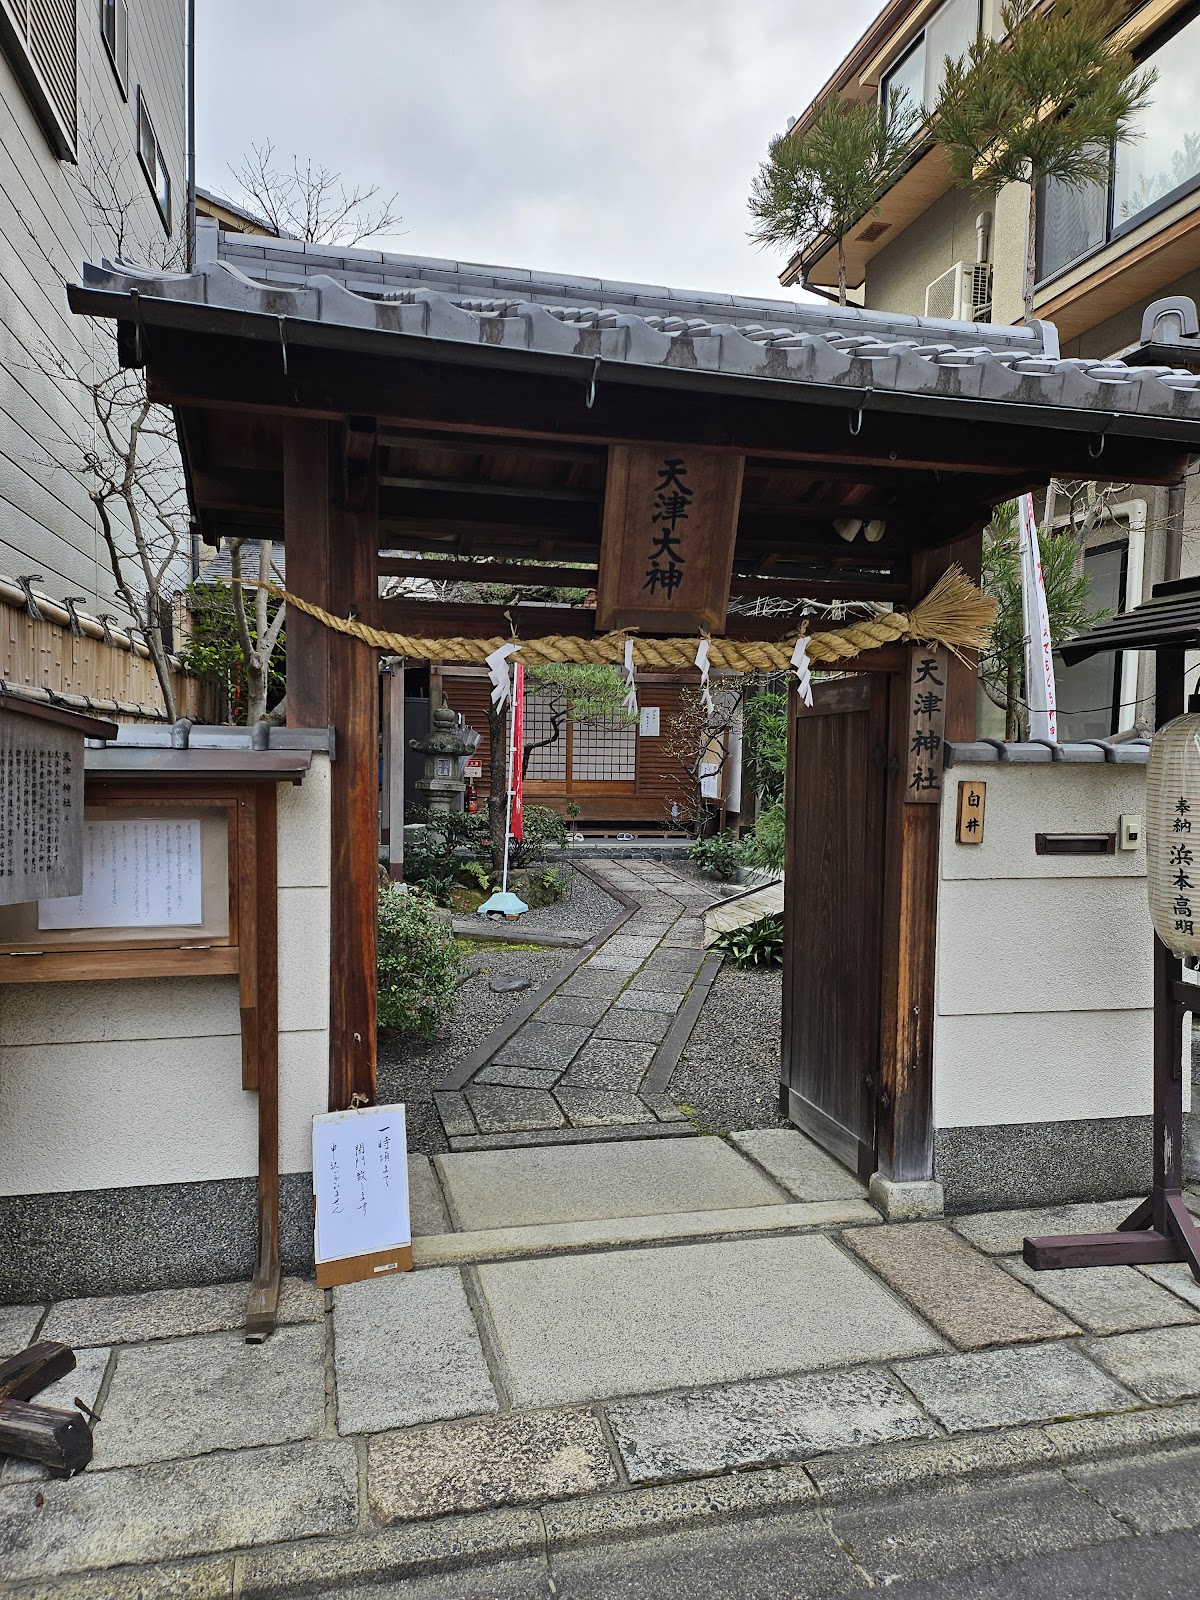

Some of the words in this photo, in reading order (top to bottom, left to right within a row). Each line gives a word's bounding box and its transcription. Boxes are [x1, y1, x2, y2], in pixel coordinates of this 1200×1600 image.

[642, 458, 693, 600] 天津大神
[909, 659, 944, 792] 天津神社
[965, 790, 981, 834] 白井
[1172, 796, 1192, 834] 奉納
[1169, 843, 1195, 936] 浜本高明
[377, 1125, 392, 1187] 一時頃まで
